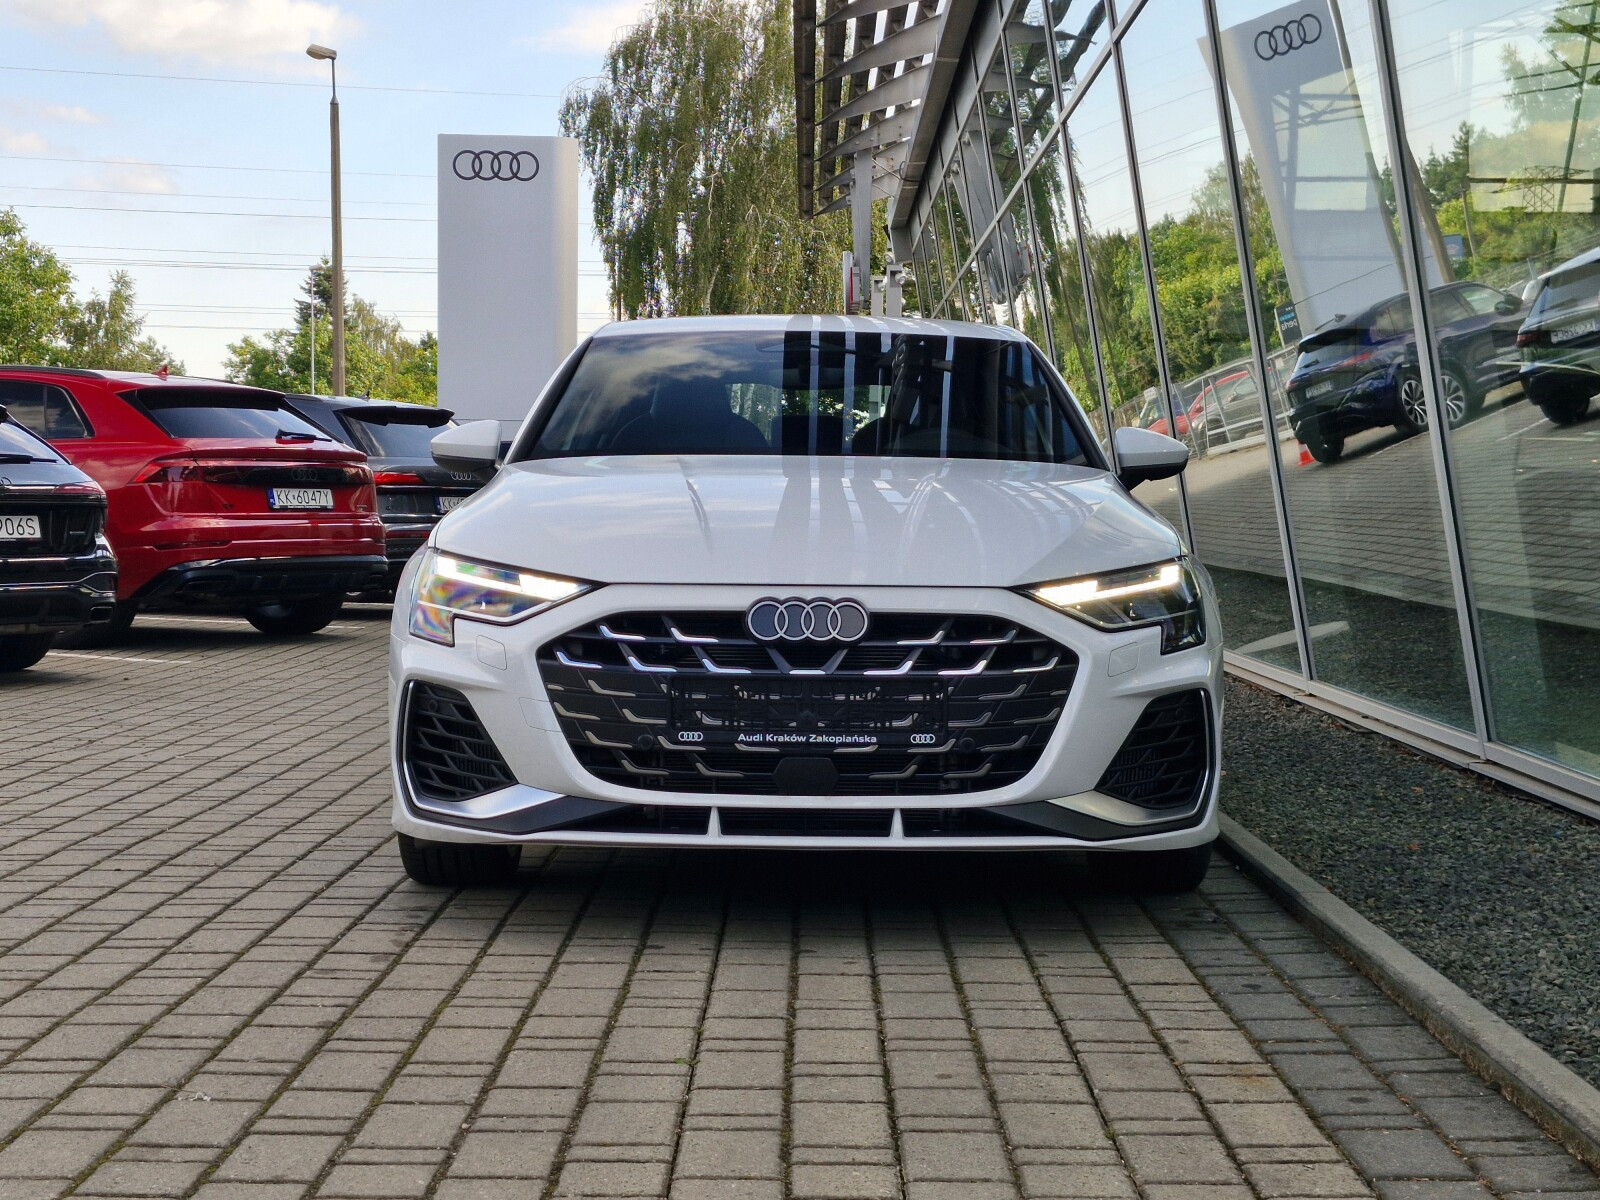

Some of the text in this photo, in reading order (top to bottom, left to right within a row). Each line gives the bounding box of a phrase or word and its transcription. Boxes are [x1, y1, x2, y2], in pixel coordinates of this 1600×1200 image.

[276, 489, 329, 504] KK 6047Y
[737, 733, 877, 745] Audi Kraków Zakopiańska
